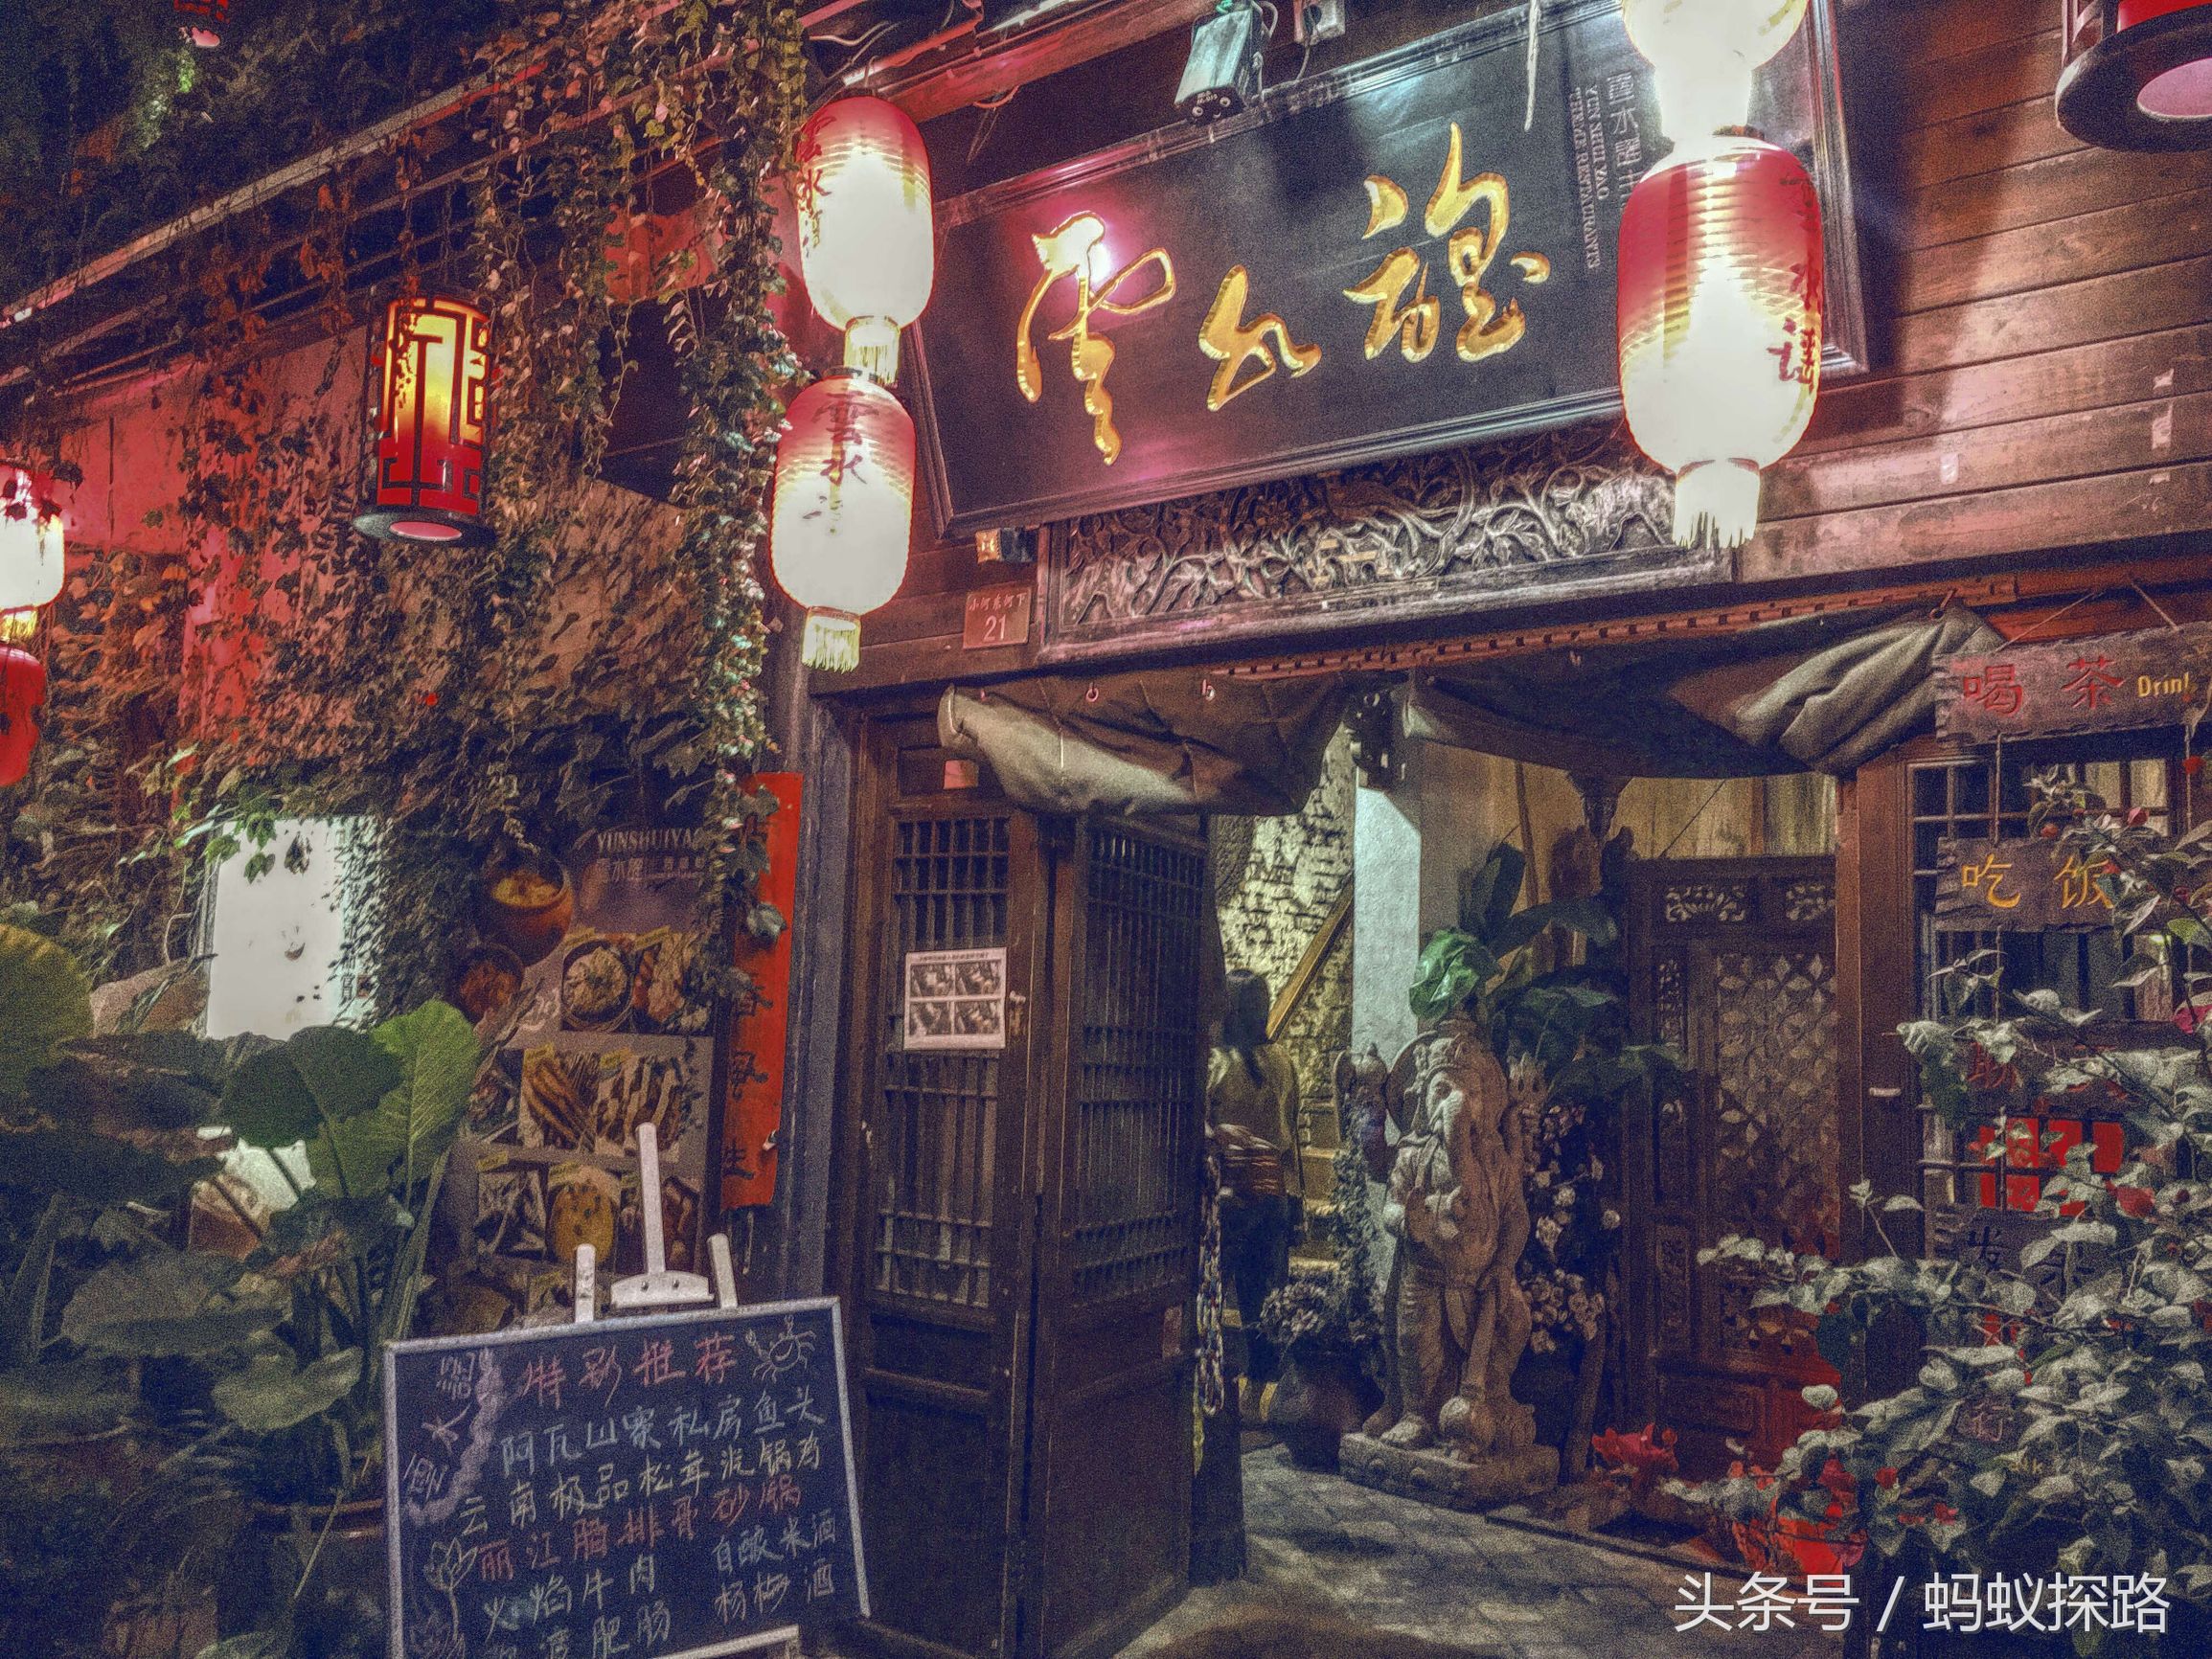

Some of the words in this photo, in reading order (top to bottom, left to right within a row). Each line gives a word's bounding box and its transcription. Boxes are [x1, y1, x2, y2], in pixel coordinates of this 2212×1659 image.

[1585, 83, 1601, 121] YUN
[1594, 165, 1610, 200] YAO
[983, 614, 1006, 643] 21
[1964, 655, 2126, 716] 喝茶
[1962, 853, 2113, 909] 吃饭
[712, 1508, 837, 1577] 自酿米酒
